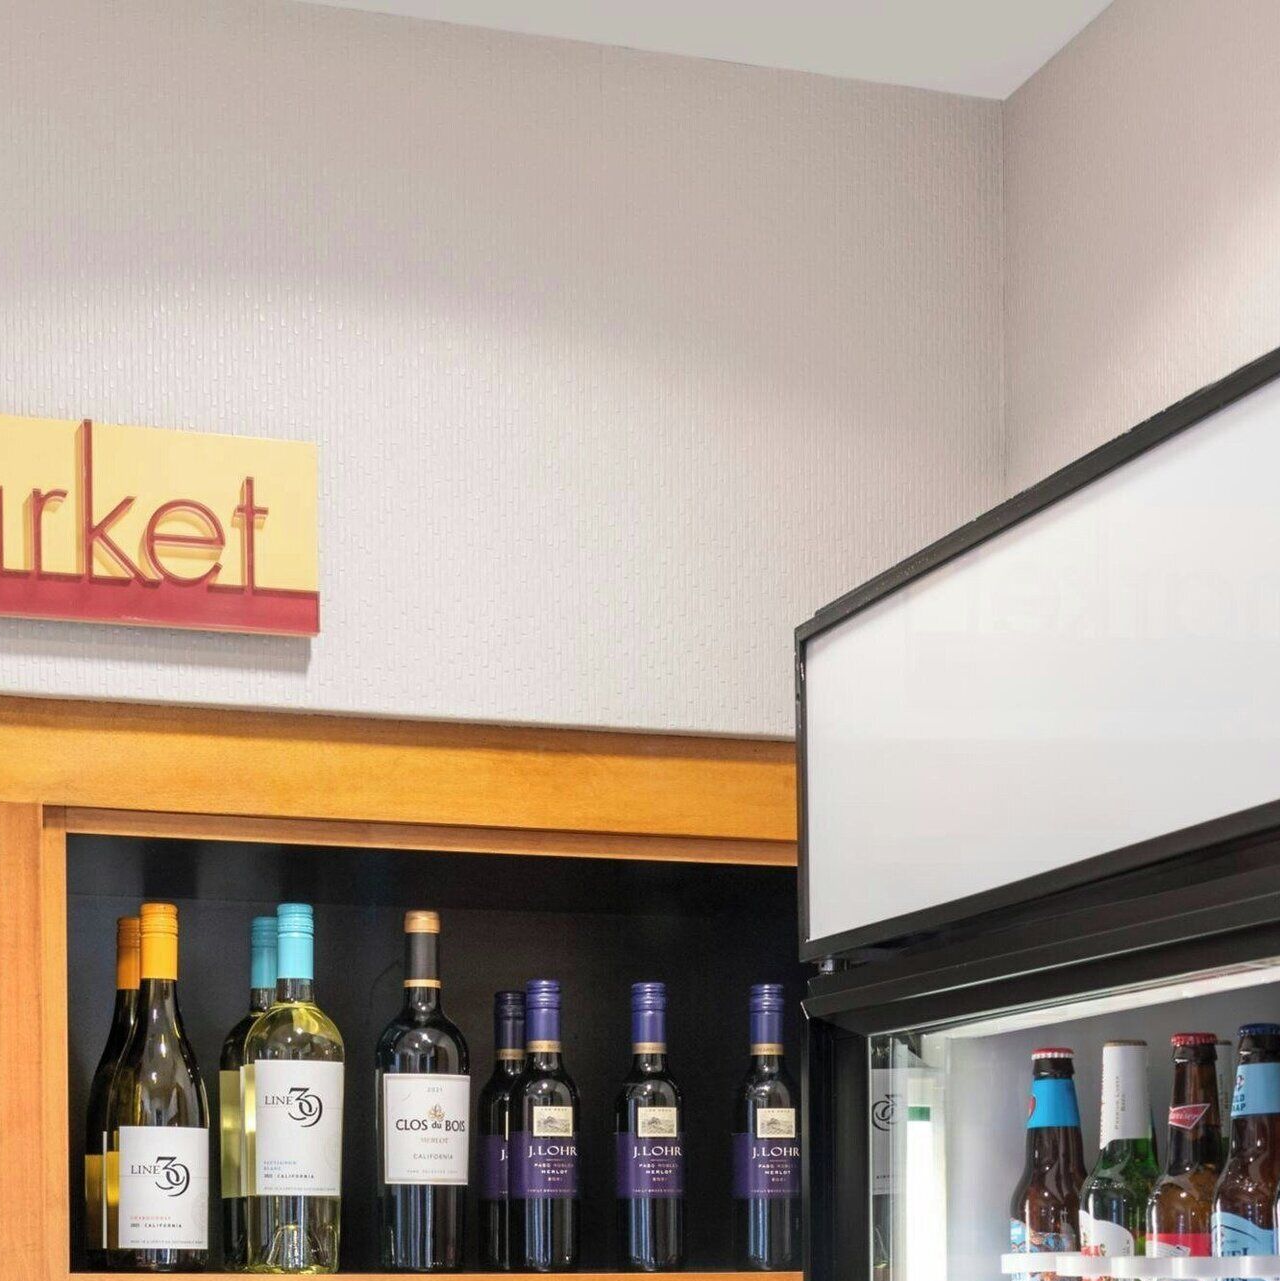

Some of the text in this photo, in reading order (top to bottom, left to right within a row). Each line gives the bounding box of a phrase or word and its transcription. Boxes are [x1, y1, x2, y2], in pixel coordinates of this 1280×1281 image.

[395, 1119, 465, 1132] CLOS du BOIS
[131, 1164, 160, 1175] LINE
